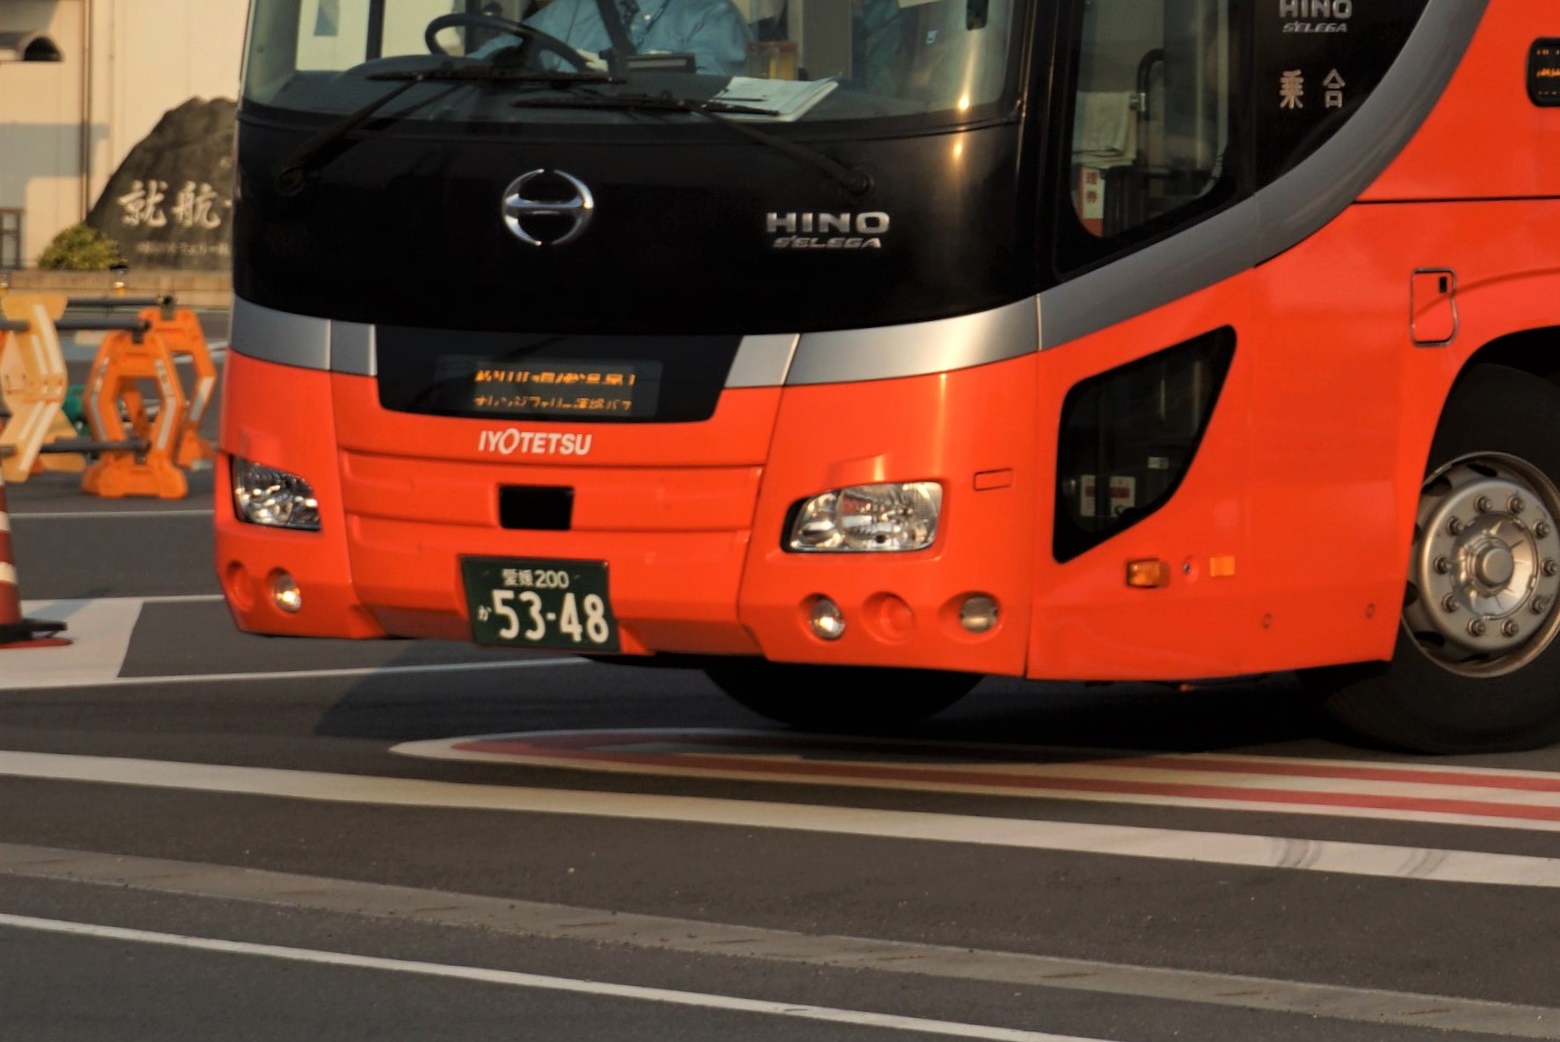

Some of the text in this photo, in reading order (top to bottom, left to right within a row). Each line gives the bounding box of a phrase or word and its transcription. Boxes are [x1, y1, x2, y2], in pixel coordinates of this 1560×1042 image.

[118, 179, 232, 230] 就航
[766, 211, 890, 234] HINO
[477, 428, 593, 456] IYOTETSU
[491, 588, 610, 644] 53-48
